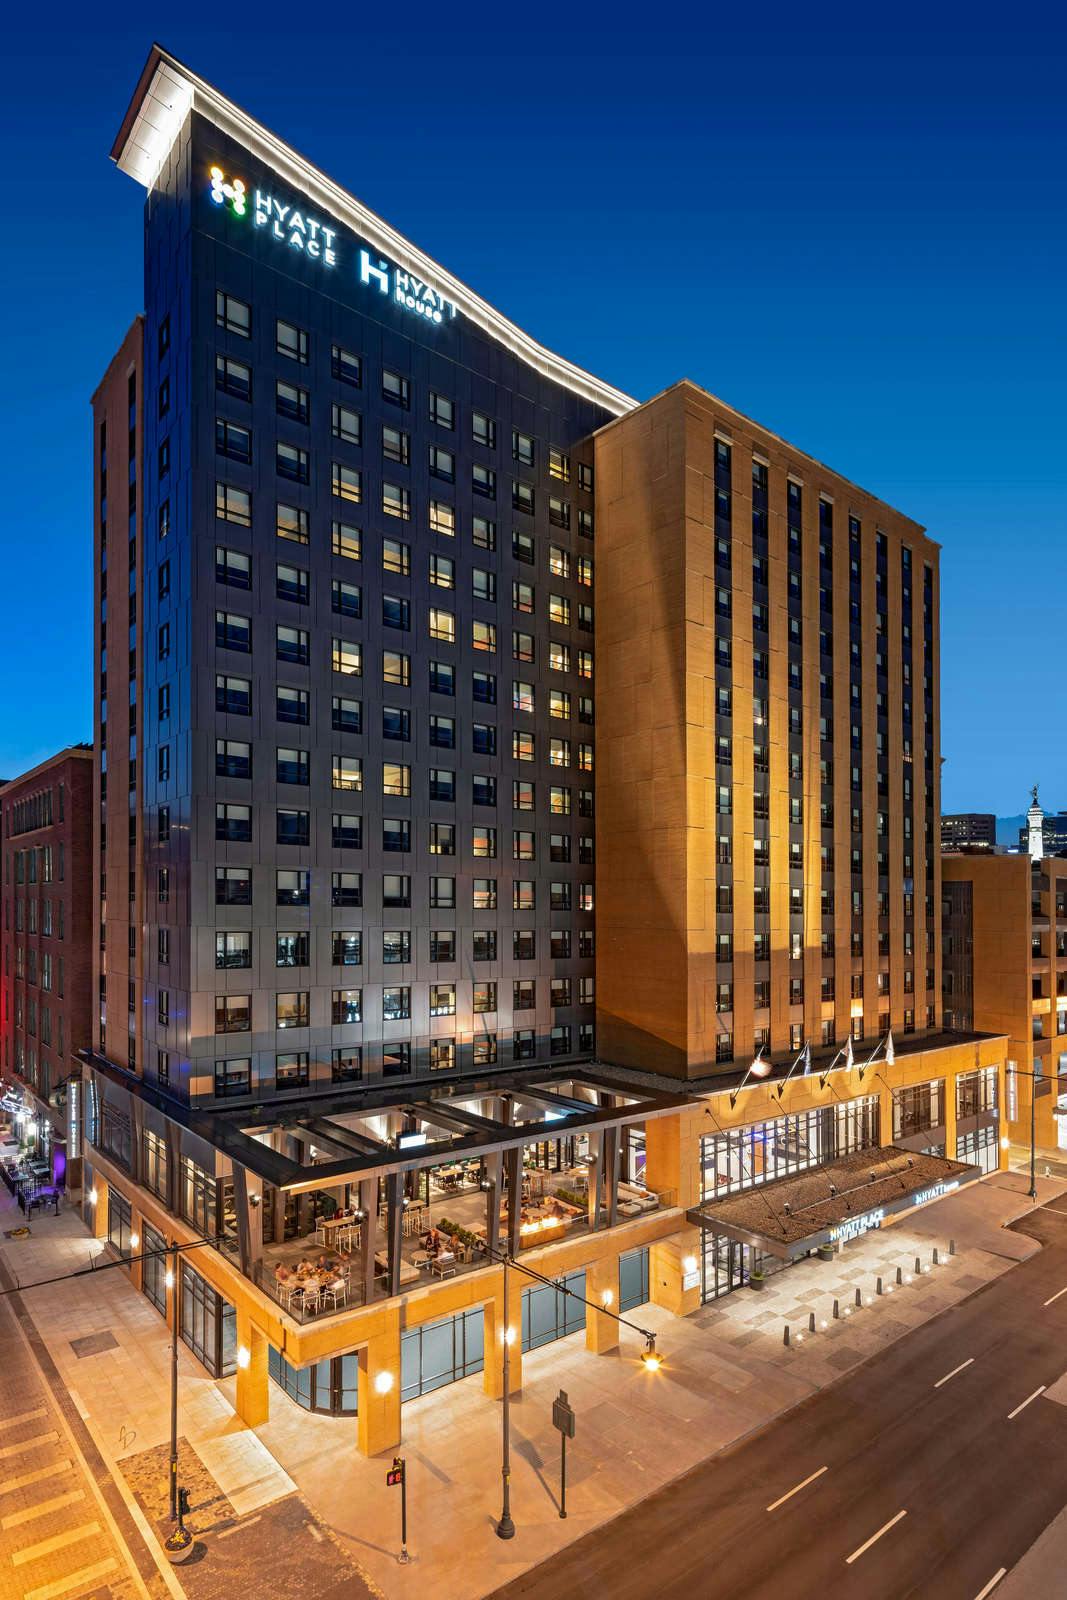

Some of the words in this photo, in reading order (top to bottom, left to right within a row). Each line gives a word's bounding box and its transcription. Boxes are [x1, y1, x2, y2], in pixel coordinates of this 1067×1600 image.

[255, 189, 336, 248] HYATT
[255, 208, 336, 267] PLACE
[394, 268, 458, 318] HYATT
[395, 286, 442, 324] house
[922, 1184, 944, 1202] HYATT
[837, 1219, 860, 1238] HYATT
[860, 1209, 884, 1228] PLACE
